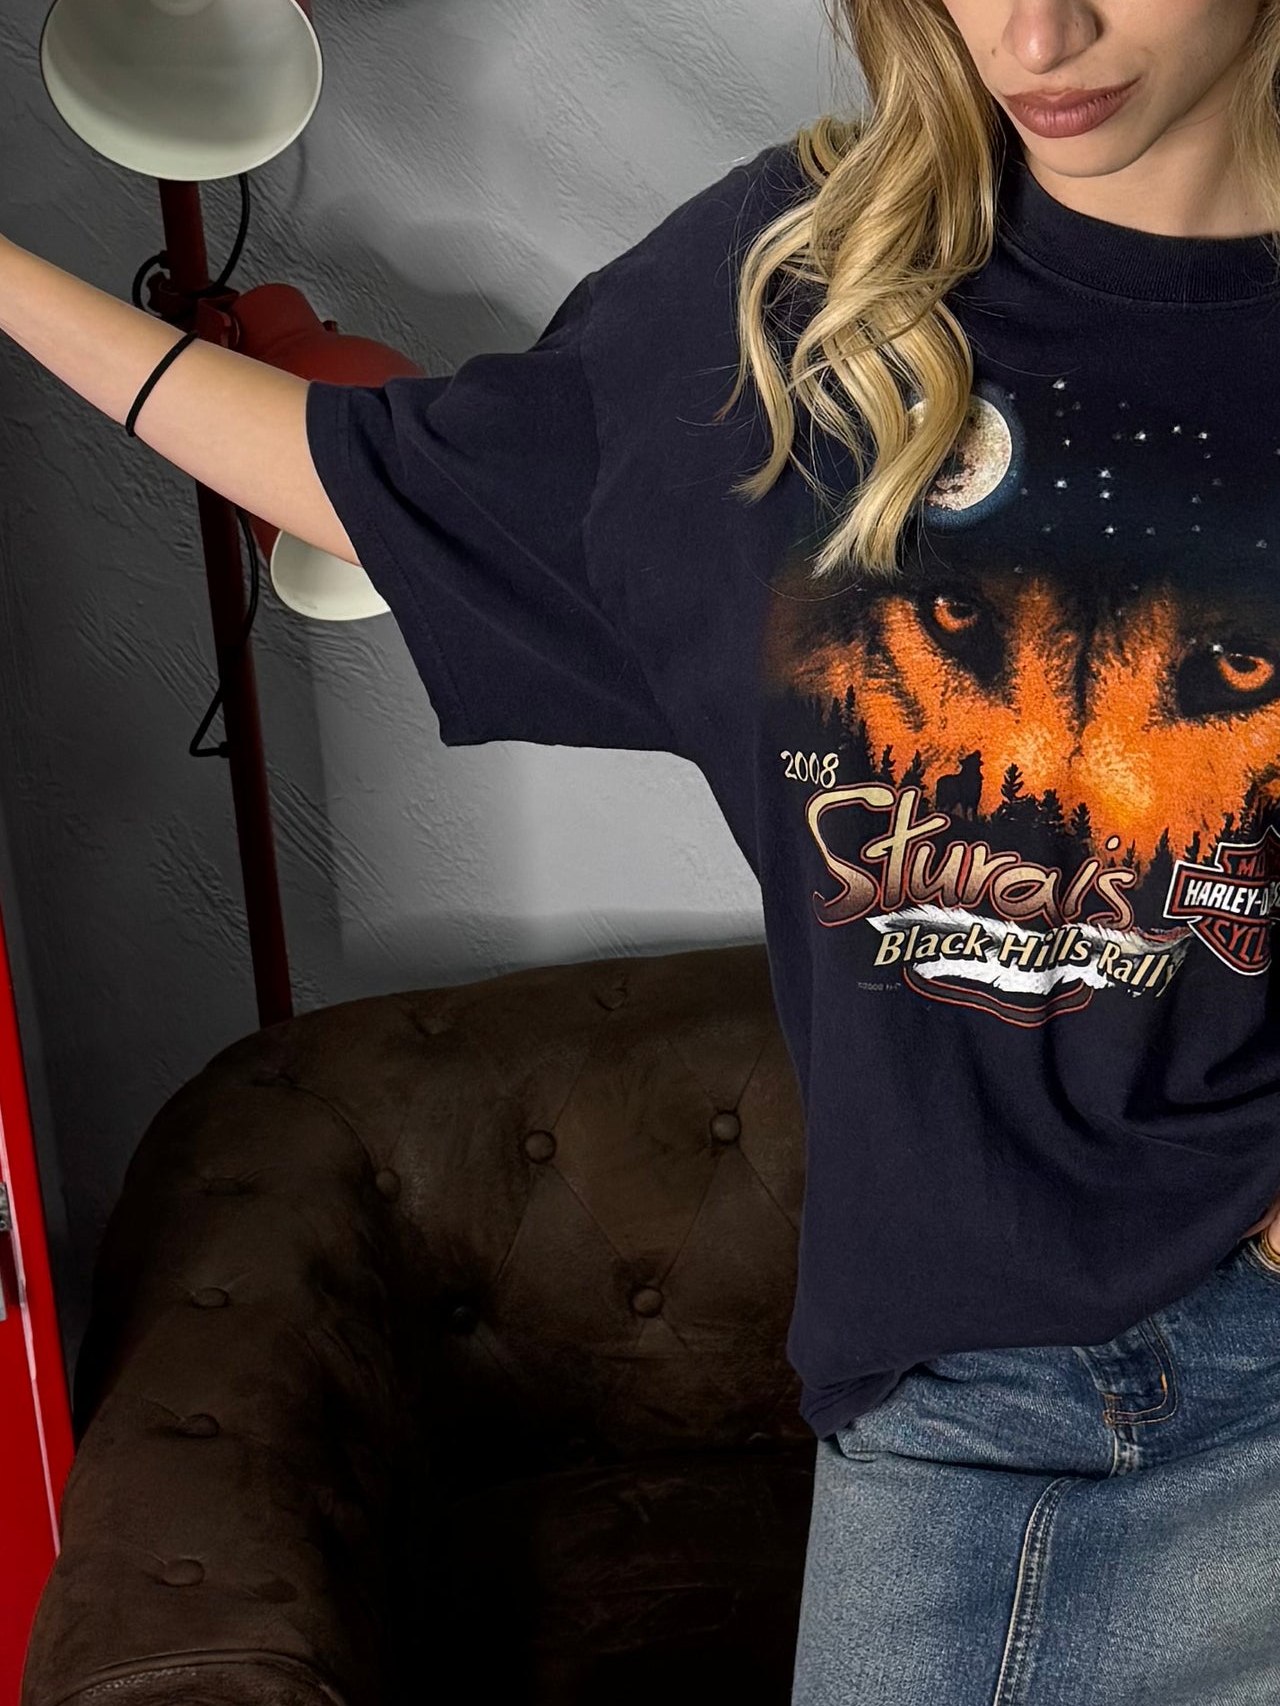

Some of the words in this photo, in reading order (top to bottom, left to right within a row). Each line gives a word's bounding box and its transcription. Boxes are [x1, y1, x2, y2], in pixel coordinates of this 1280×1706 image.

[780, 750, 840, 789] 2008
[875, 923, 990, 966] Black
[999, 924, 1092, 970] Hills
[1097, 941, 1185, 997] Rally
